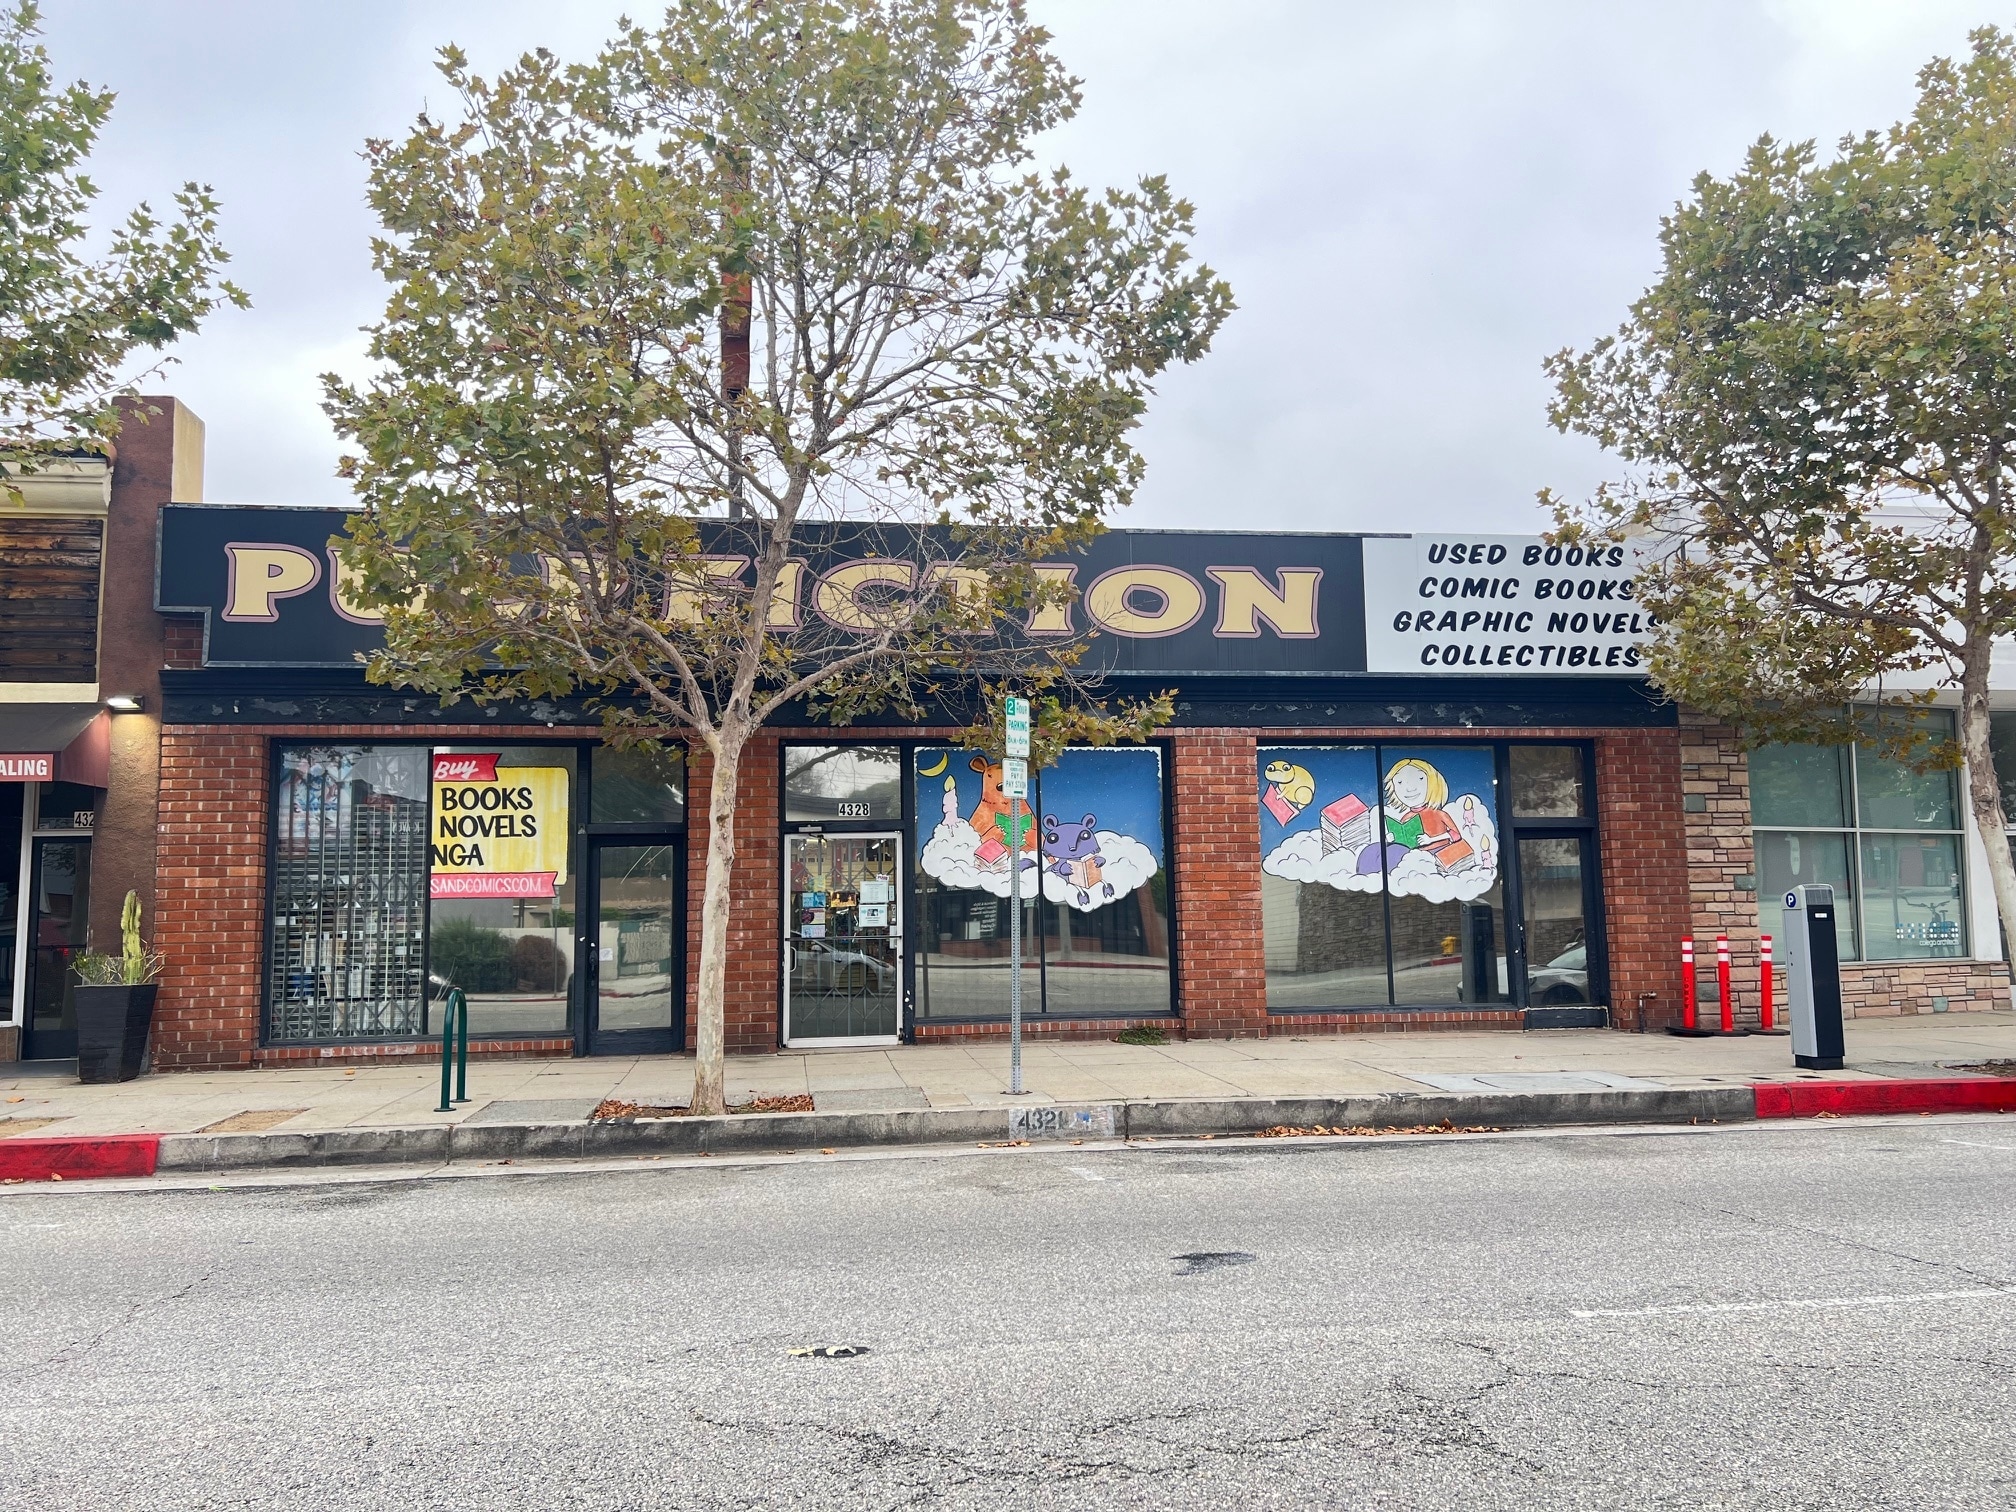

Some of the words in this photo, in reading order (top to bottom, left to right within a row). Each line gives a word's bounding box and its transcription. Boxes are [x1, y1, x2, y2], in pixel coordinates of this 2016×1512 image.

[1428, 543, 1507, 565] USED
[1522, 545, 1624, 567] BOOKS
[221, 541, 630, 629] PUP
[658, 552, 1323, 640] FICTION
[1418, 576, 1520, 599] COMIC
[1534, 578, 1635, 600] BOOKS
[1393, 610, 1534, 633] GRAPHIC
[1547, 612, 1664, 634] NOVELS
[1420, 644, 1641, 668] COLLECTIBLES
[1007, 700, 1014, 714] 2
[441, 787, 533, 811] BOOKS
[839, 803, 869, 816] 4328
[440, 815, 537, 838] NOVELS
[431, 843, 484, 867] NGA
[1788, 895, 1795, 906] P
